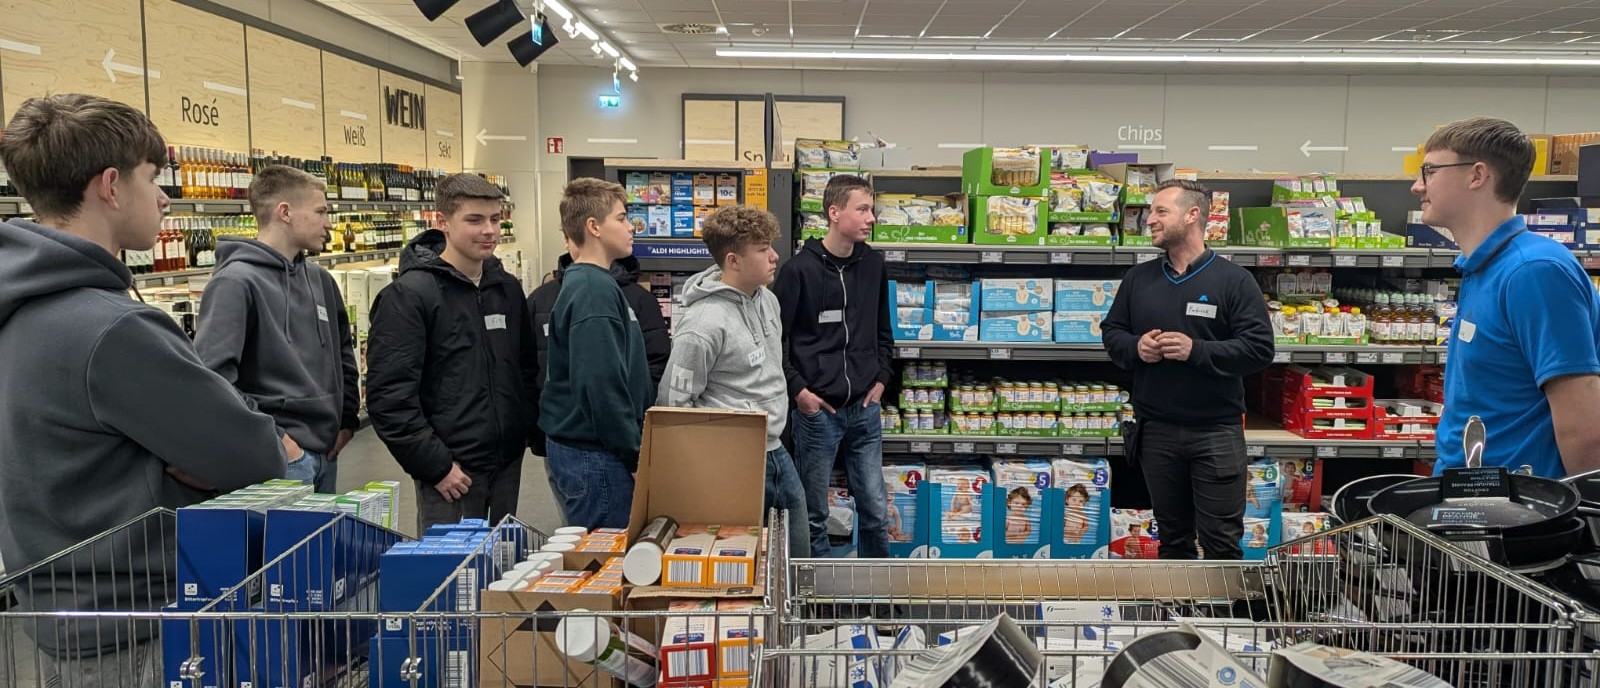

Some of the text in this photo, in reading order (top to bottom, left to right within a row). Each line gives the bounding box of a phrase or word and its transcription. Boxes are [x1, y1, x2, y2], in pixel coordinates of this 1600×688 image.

[181, 96, 219, 126] Rosé
[384, 86, 425, 131] WEIN
[343, 125, 366, 147] Weiß
[1118, 124, 1162, 145] Chips
[438, 141, 452, 158] Sekt
[1305, 461, 1313, 472] 6
[908, 474, 916, 485] 4
[1096, 471, 1104, 482] 5
[1265, 469, 1273, 479] 6
[1039, 475, 1046, 486] 5
[1151, 521, 1159, 532] 5
